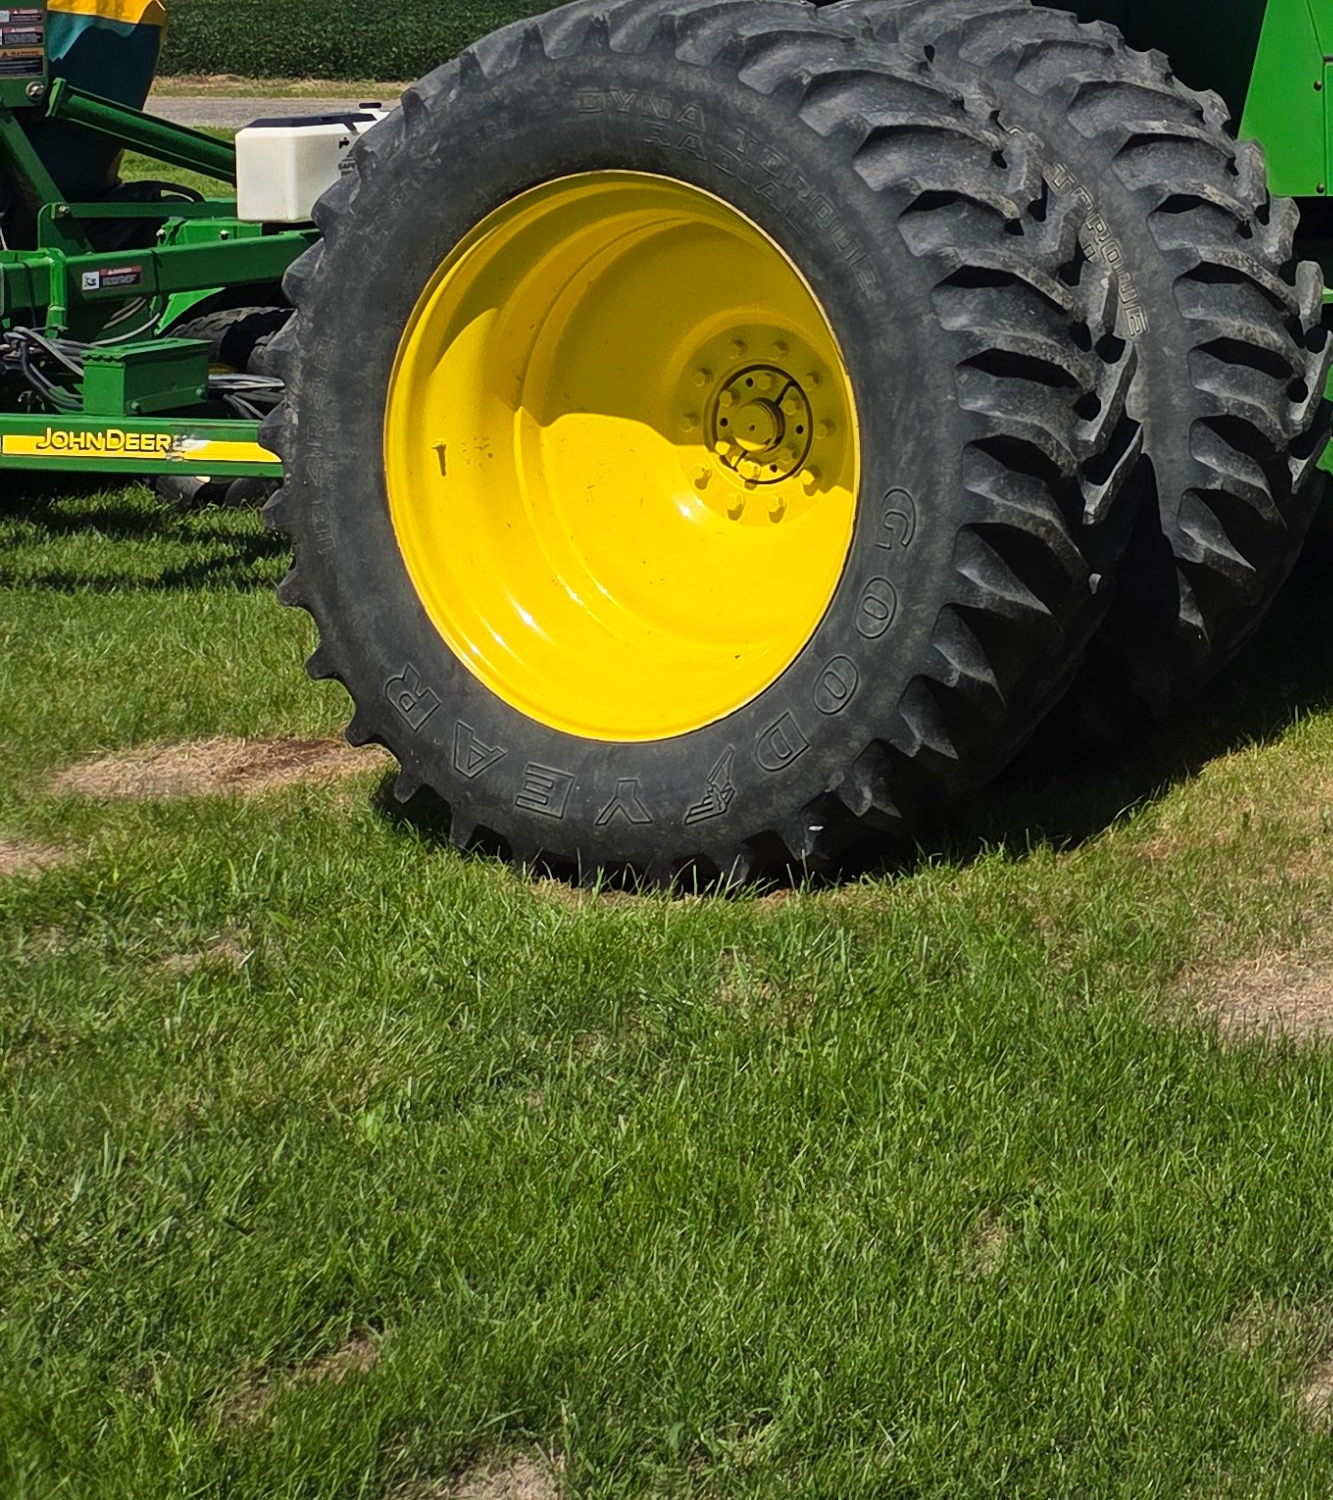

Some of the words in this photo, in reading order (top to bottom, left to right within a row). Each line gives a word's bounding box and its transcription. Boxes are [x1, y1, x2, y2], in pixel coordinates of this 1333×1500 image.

[577, 83, 707, 134] DYNA
[734, 125, 888, 304] TORQUE
[37, 427, 103, 451] JOHN
